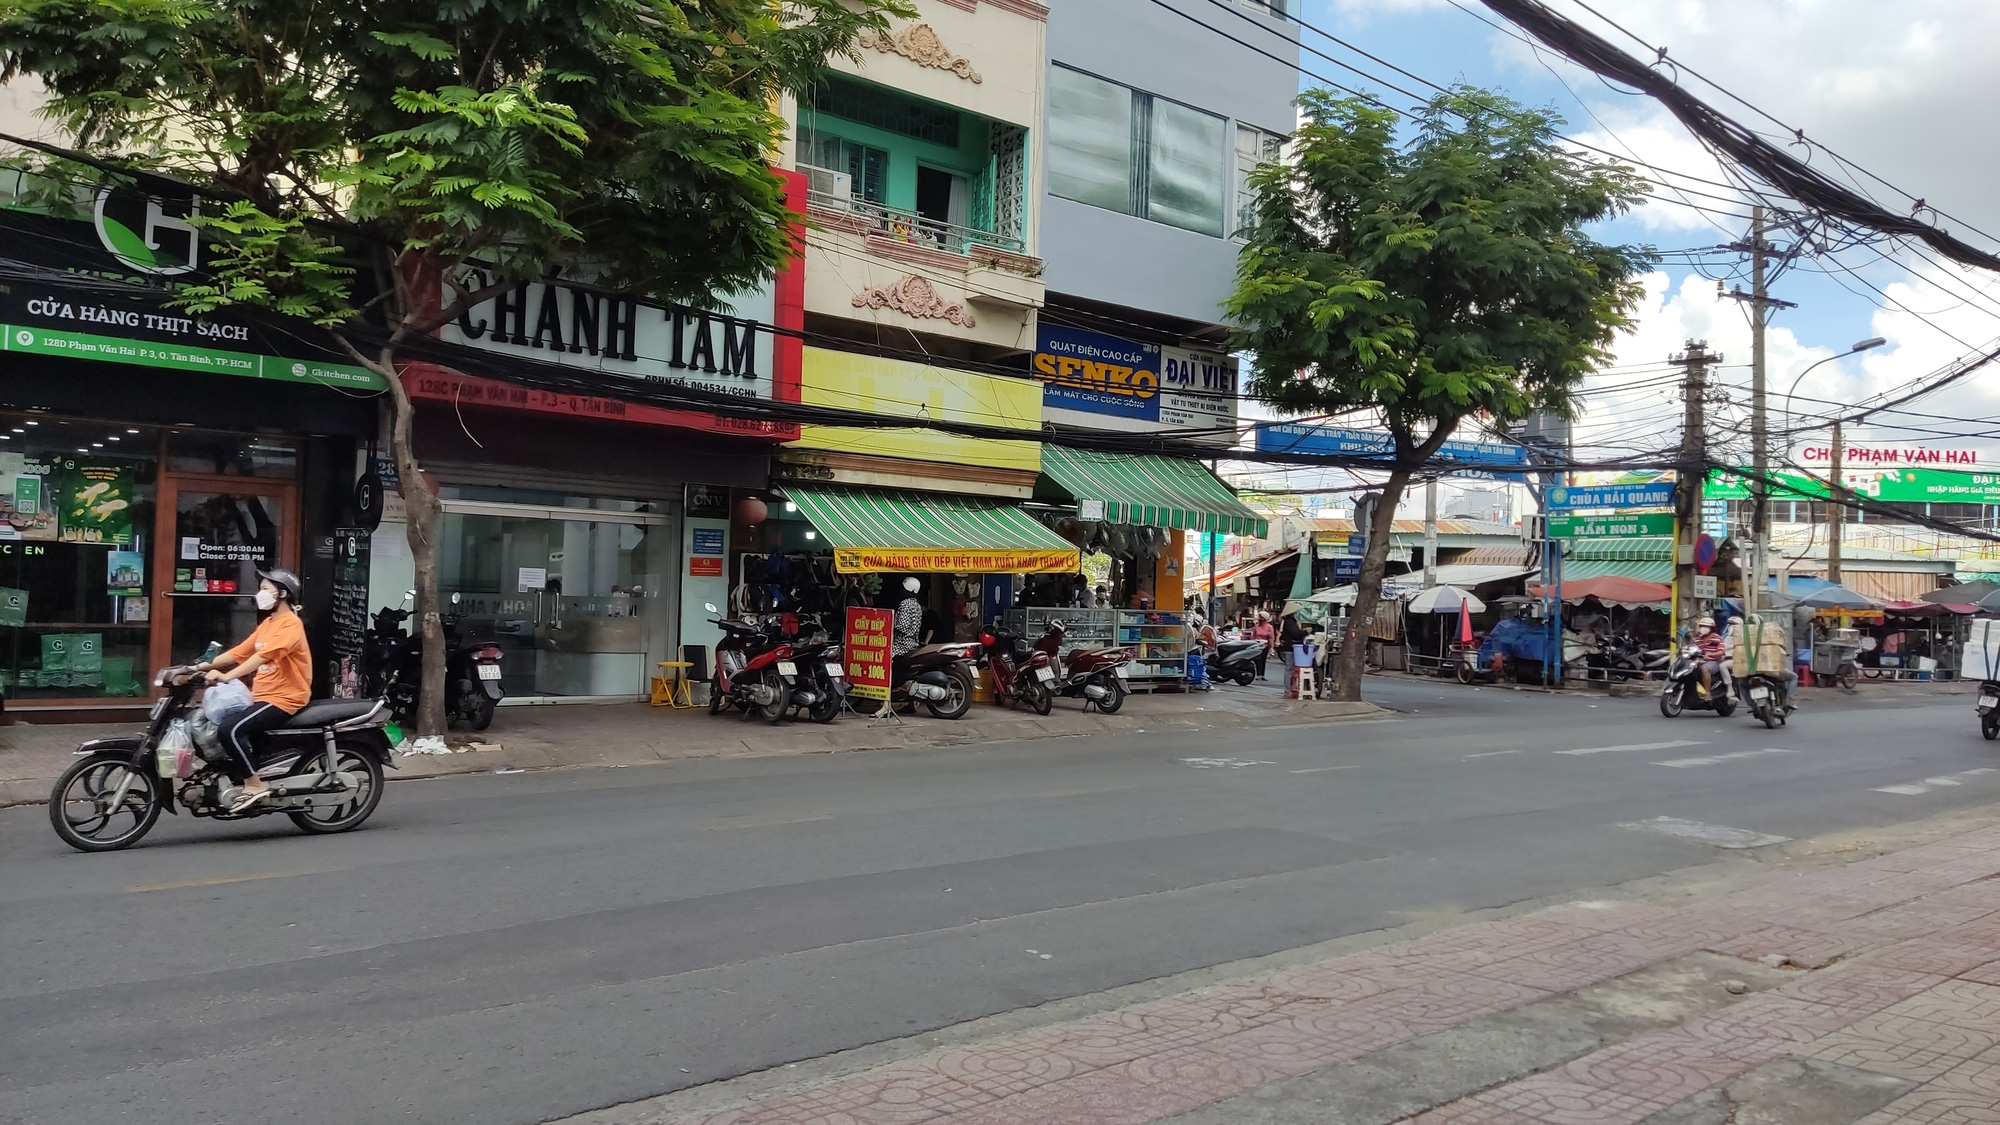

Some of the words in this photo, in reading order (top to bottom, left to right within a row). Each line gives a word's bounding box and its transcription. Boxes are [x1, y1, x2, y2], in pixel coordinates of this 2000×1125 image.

[27, 295, 74, 319] CỬA
[79, 304, 139, 327] HÀNG
[144, 313, 193, 336] THỊT
[43, 337, 67, 348] 128D
[1049, 340, 1077, 354] QUẠT
[1077, 345, 1101, 358] ĐIỆN
[1101, 349, 1122, 360] CAO
[1123, 352, 1143, 364] CẤP
[1034, 352, 1158, 399] SENKO
[1164, 357, 1196, 389] ĐẠI
[1200, 361, 1238, 393] VIỆT
[1081, 393, 1099, 402] CHO
[1803, 447, 1843, 461] CH
[1848, 448, 1898, 467] PHẠM
[1904, 446, 1940, 464] VĂN
[1945, 450, 1976, 464] HAI
[1926, 485, 1948, 495] NHẬP
[1569, 493, 1601, 506] CHÙA
[1604, 491, 1625, 504] HẢI
[1628, 491, 1669, 504] QUANG
[1609, 524, 1638, 534] NON
[1639, 524, 1649, 534] 3
[200, 544, 226, 553] Open:
[200, 552, 226, 560] Close:
[227, 553, 250, 561] 07:30
[863, 551, 883, 568] CỬA
[884, 553, 910, 569] HÀNG
[912, 553, 932, 568] GIÀY
[934, 553, 951, 568] DÉP
[952, 553, 971, 571] VIỆT
[972, 556, 992, 568] NAM
[994, 552, 1015, 569] XUẤT
[852, 649, 874, 663] THANH
[874, 649, 885, 664] LÝ
